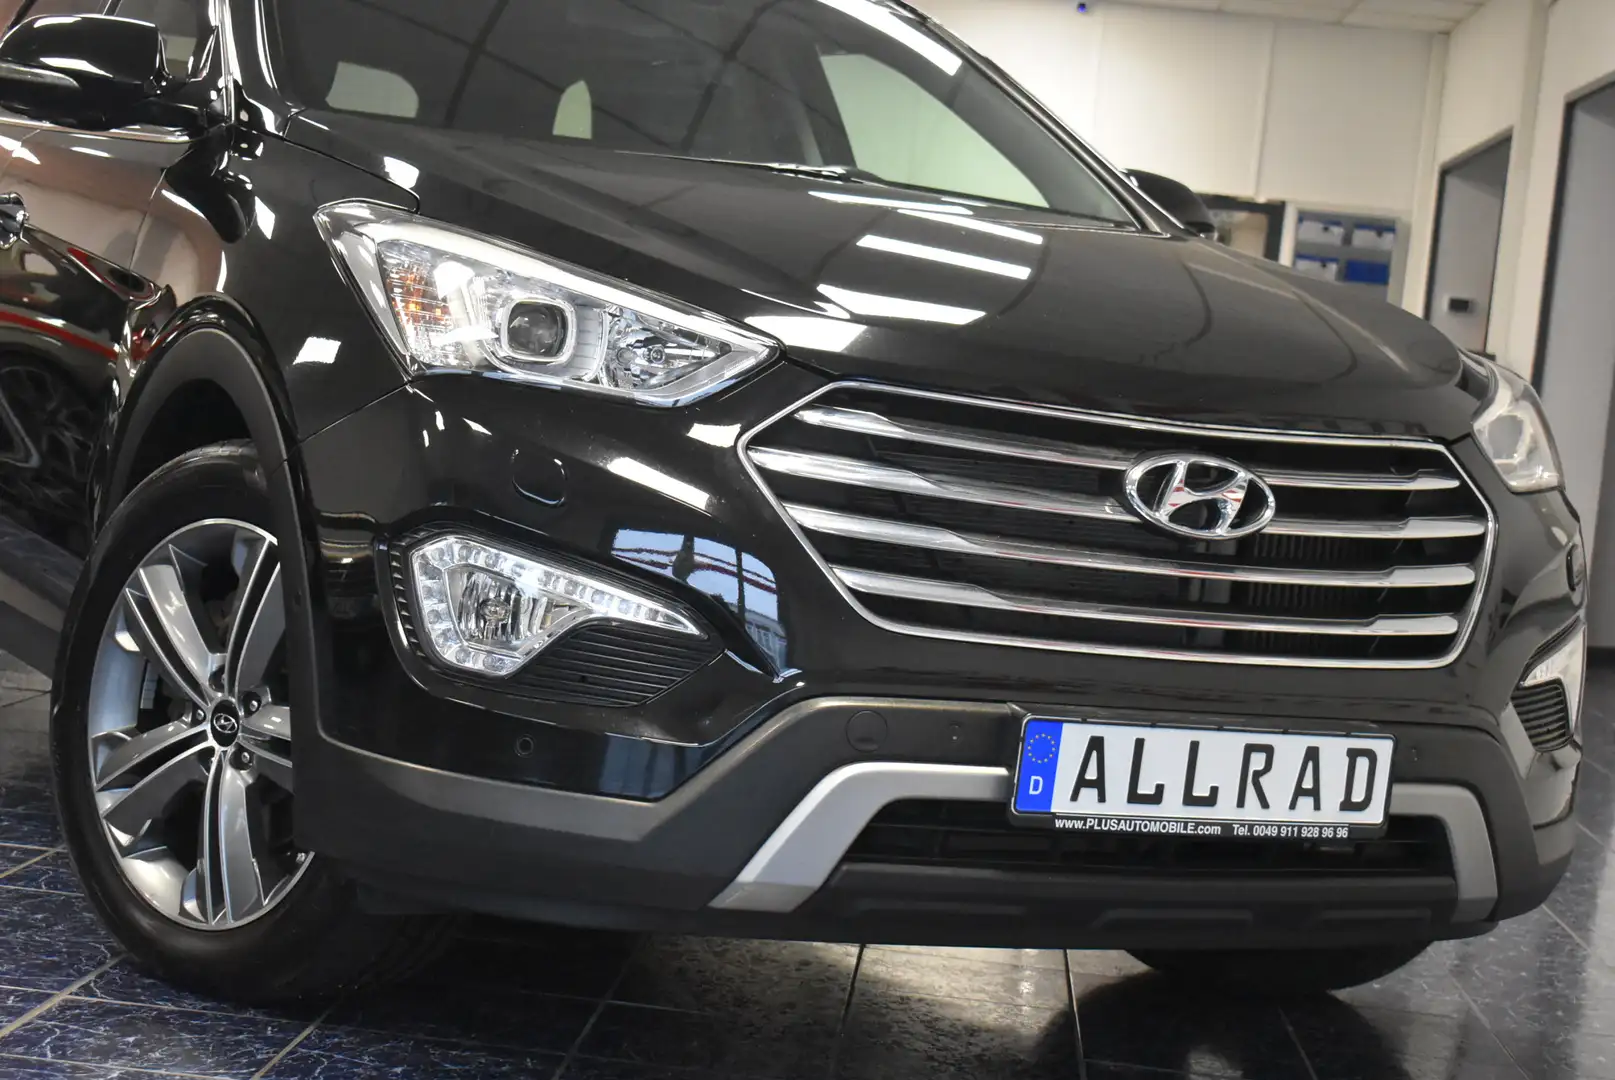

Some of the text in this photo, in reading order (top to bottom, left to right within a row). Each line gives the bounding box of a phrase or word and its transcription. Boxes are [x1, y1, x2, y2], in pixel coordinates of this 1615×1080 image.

[1070, 735, 1378, 811] ALLRAD
[1029, 775, 1043, 796] D
[1054, 817, 1348, 838] www.PLUSAUTOMOBILE.com Tel. 0049 911 928 96 96
